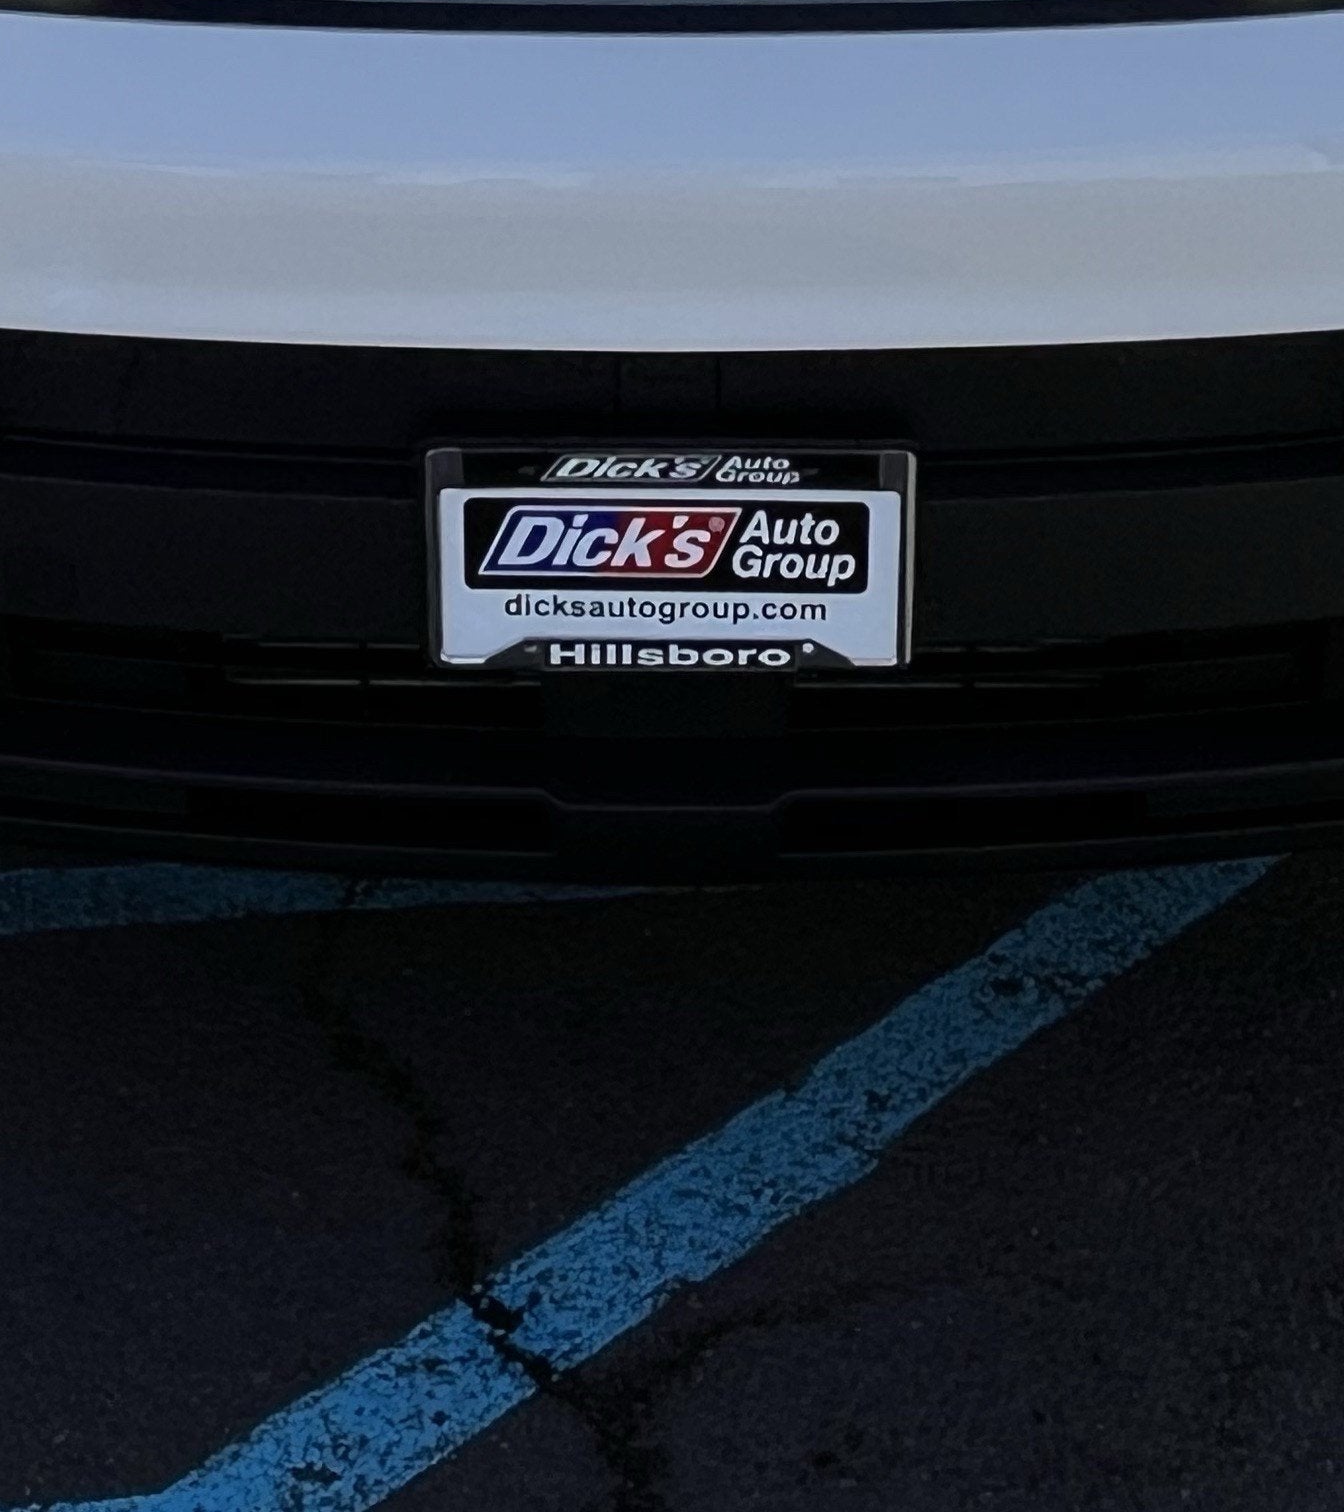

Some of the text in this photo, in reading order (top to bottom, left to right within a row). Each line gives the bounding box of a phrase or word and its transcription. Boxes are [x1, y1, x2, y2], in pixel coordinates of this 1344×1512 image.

[715, 467, 800, 485] Group
[726, 455, 790, 470] Auto
[497, 509, 840, 570] Dick's Auto
[732, 544, 856, 586] Group
[504, 593, 827, 624] dicksautogroup.com
[550, 643, 792, 666] Hillsboro
